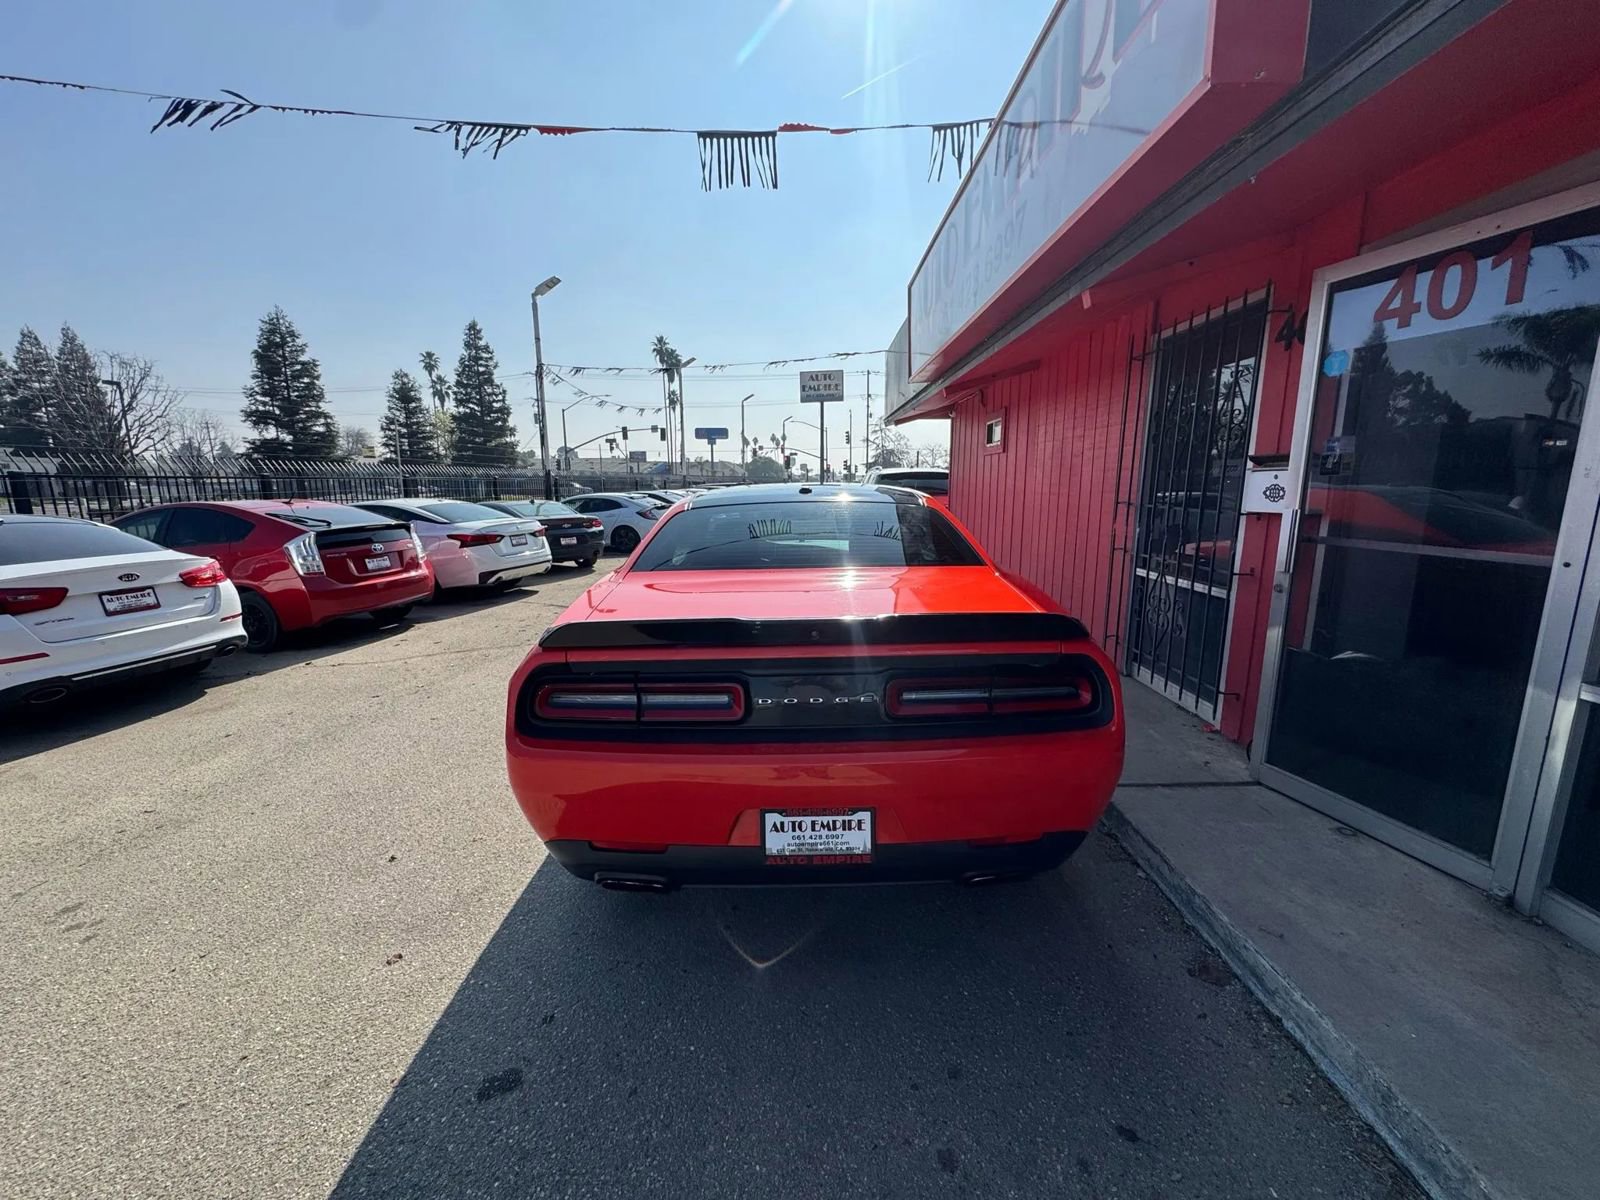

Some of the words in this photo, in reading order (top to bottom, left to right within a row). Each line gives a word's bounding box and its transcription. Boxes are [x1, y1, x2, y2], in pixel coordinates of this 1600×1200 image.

[1374, 230, 1534, 329] 401
[808, 373, 835, 381] AUTO
[801, 384, 841, 392] EMPIRE
[770, 820, 808, 833] AUTO
[811, 819, 867, 832] EMPIRE
[791, 833, 845, 841] 661.428.6997
[766, 857, 807, 865] AUTO
[812, 855, 872, 864] EMPIRE
